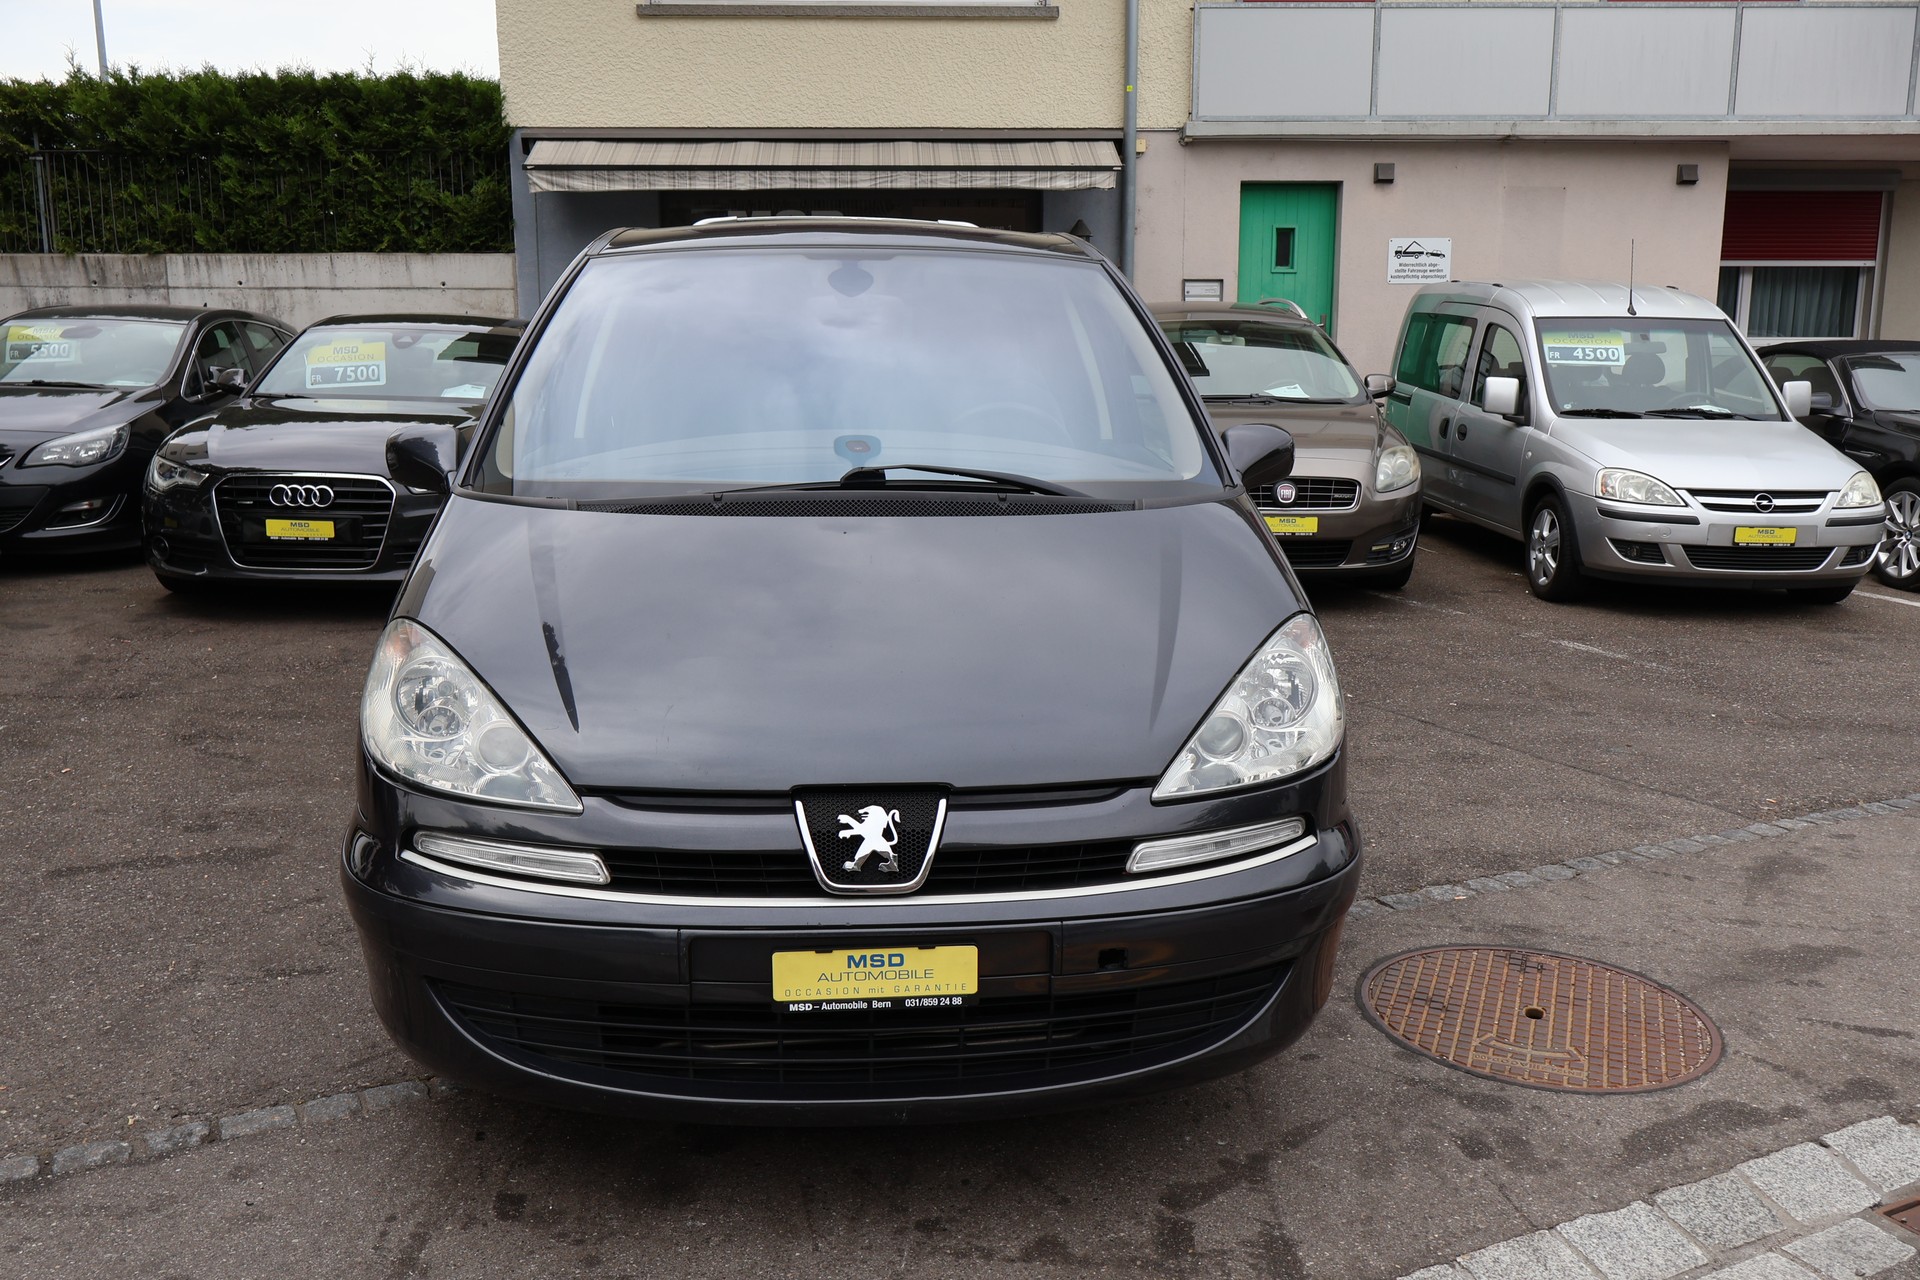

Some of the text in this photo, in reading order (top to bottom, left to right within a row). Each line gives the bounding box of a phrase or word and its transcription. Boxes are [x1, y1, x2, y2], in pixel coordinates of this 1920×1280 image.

[1568, 331, 1594, 339] MSD
[9, 343, 69, 358] FR 5500
[332, 345, 359, 355] MSD
[1549, 347, 1619, 360] FR 4500
[317, 353, 375, 363] OCCASION
[311, 365, 379, 383] FR 7500
[1280, 489, 1292, 499] FIAT
[847, 953, 904, 969] MSD
[817, 969, 934, 983] AUTOMOBILE
[784, 983, 967, 997] OCCASION mit GARANTIE
[789, 1003, 813, 1012] MSD
[821, 1001, 868, 1011] Automobile
[872, 1000, 891, 1009] Bern
[905, 998, 938, 1007] 031/859
[940, 997, 950, 1006] 24
[951, 996, 962, 1005] 88
